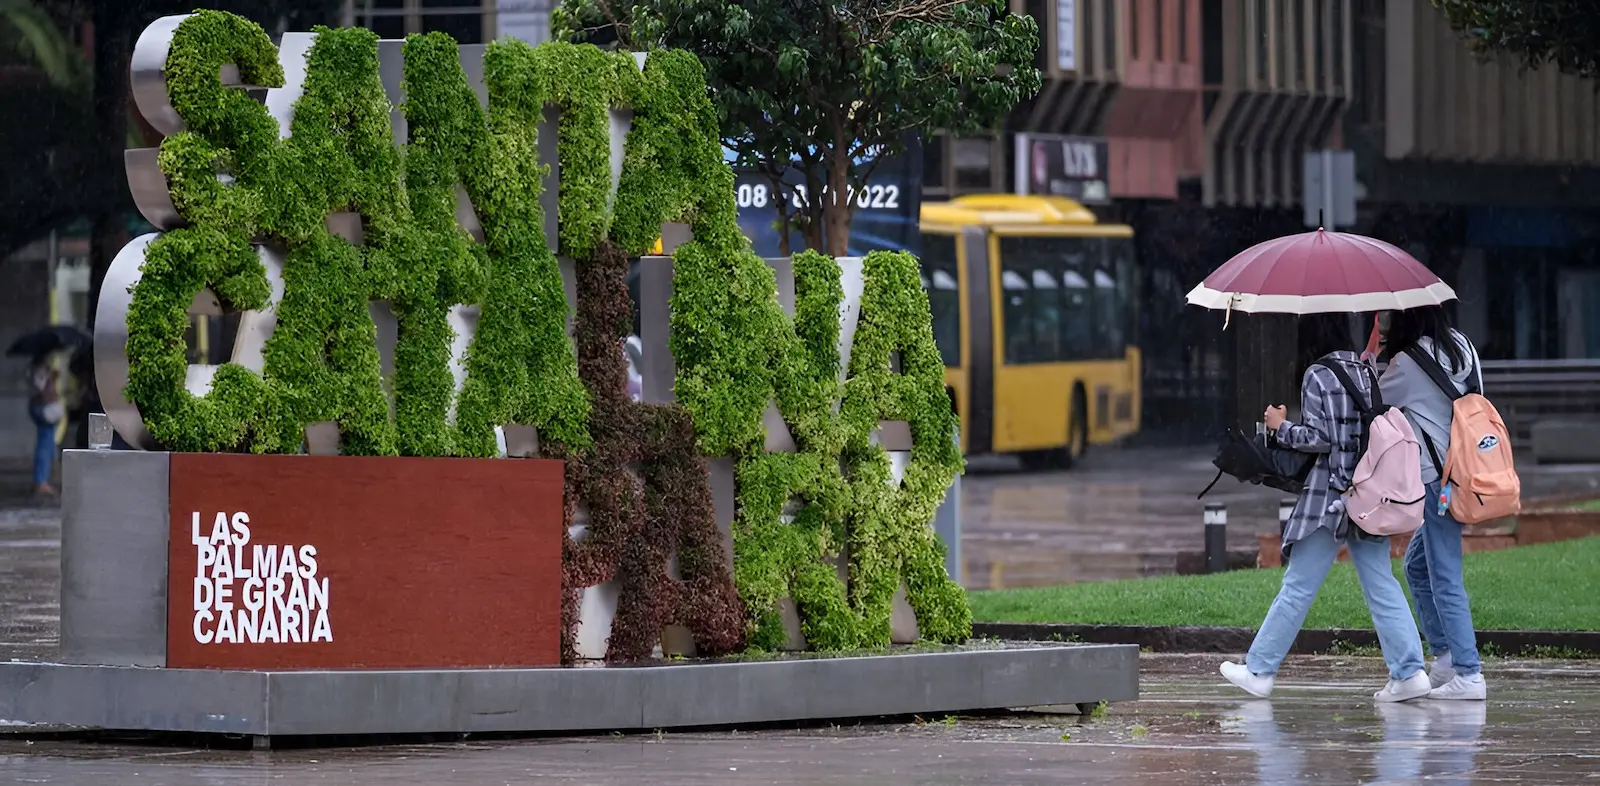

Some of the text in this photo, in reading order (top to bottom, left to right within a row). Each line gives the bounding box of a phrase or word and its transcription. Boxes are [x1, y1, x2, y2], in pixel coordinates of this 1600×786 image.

[160, 9, 738, 254] SANTA
[192, 511, 251, 546] LAS
[197, 536, 318, 579] PALMAS
[193, 576, 329, 611] DE GRAN
[193, 609, 334, 644] CANARIA
